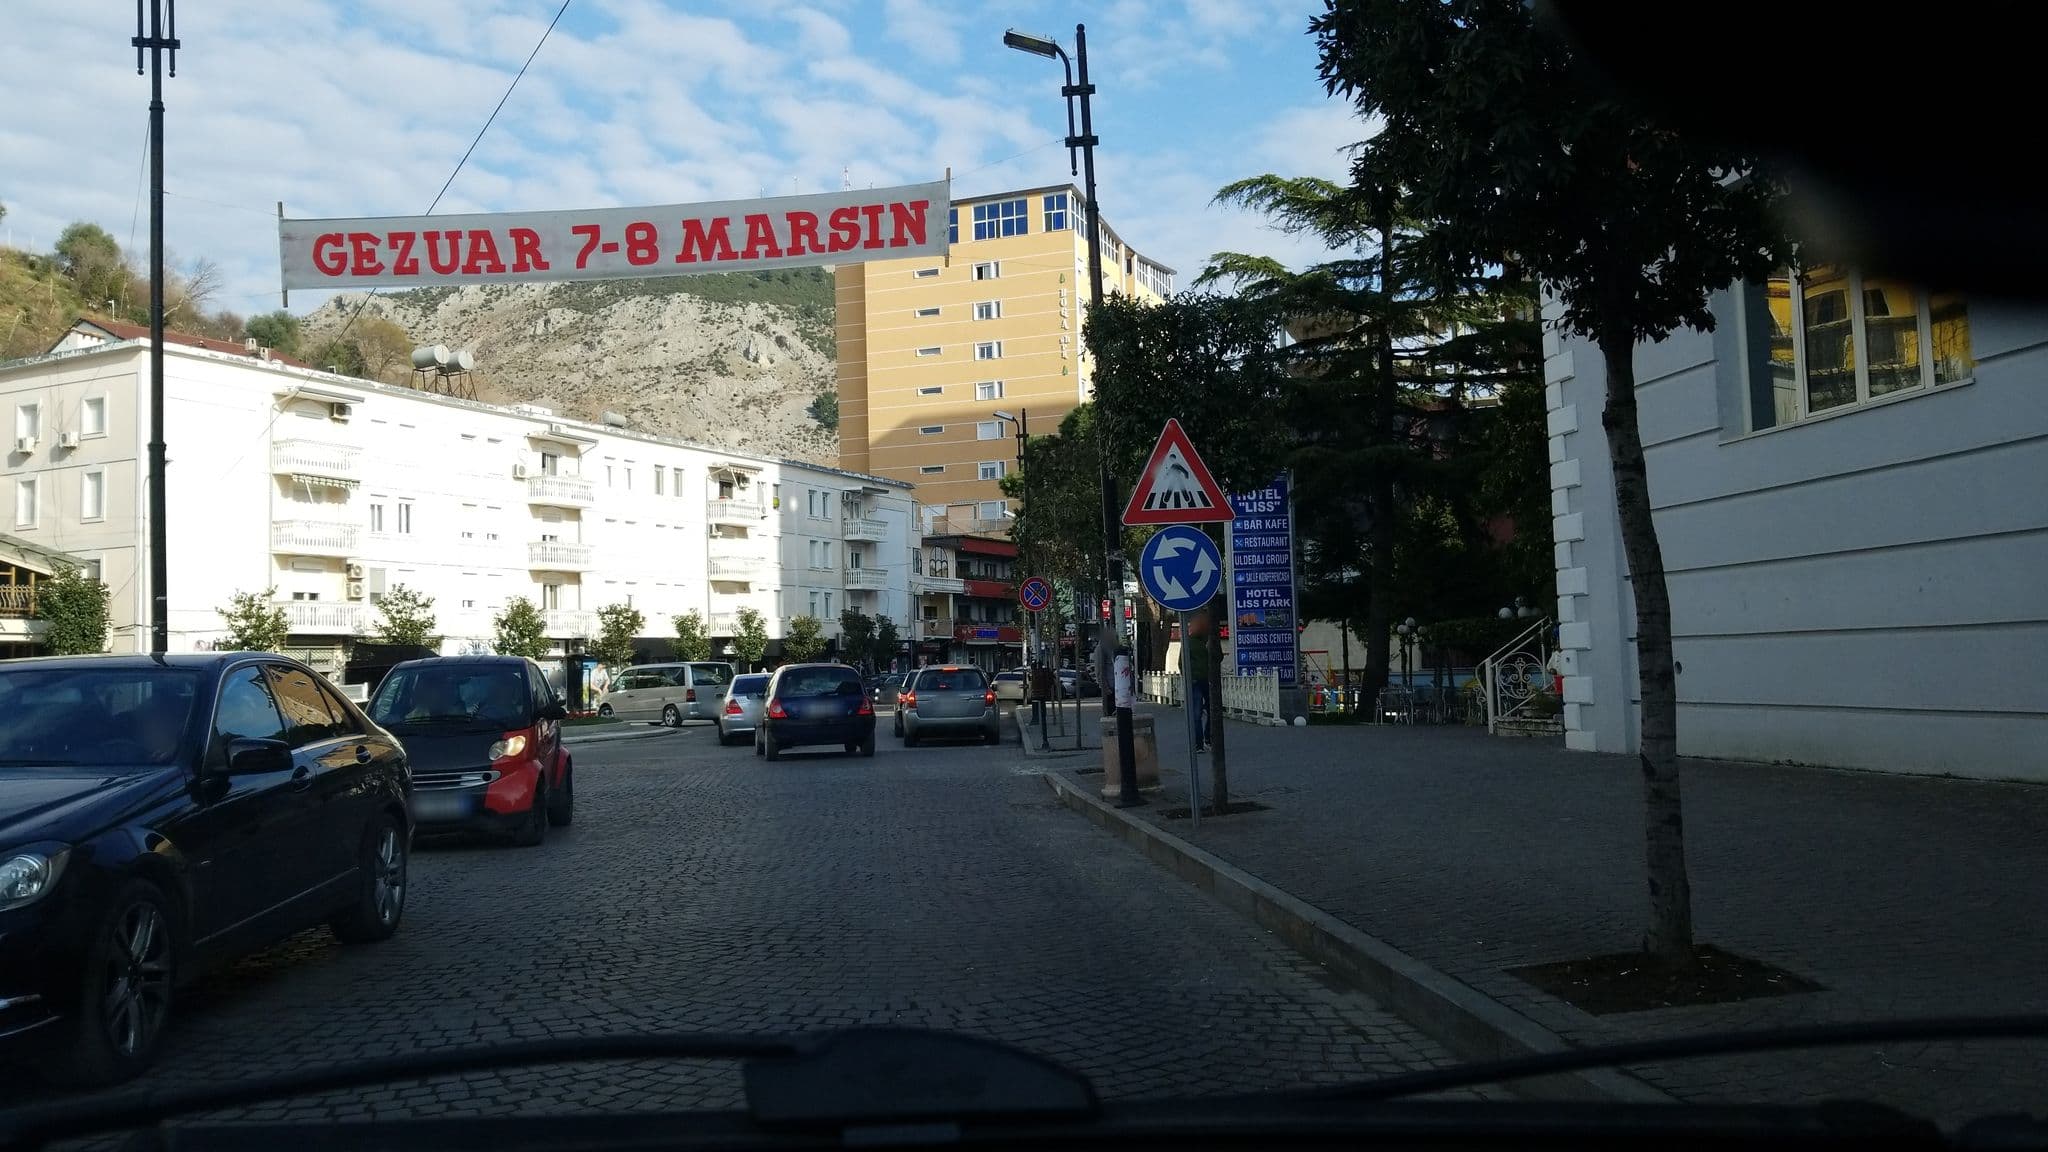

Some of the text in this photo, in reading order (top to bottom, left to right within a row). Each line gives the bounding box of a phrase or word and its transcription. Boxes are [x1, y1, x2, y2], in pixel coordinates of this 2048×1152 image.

[312, 200, 929, 276] GEZUAR 7-8 MARSIN
[1244, 518, 1288, 530] BAR KAFE
[1244, 537, 1288, 547] RESTAURANT
[1266, 554, 1289, 564] GROUP
[1246, 589, 1280, 598] HOTEL
[1236, 599, 1291, 608] LISS PARK
[1238, 633, 1292, 644] BUSINESS CENTER
[1248, 651, 1268, 661] PARKING
[1269, 651, 1282, 661] HOTEL
[1283, 650, 1293, 661] LISS
[1280, 669, 1293, 678] TAXI
